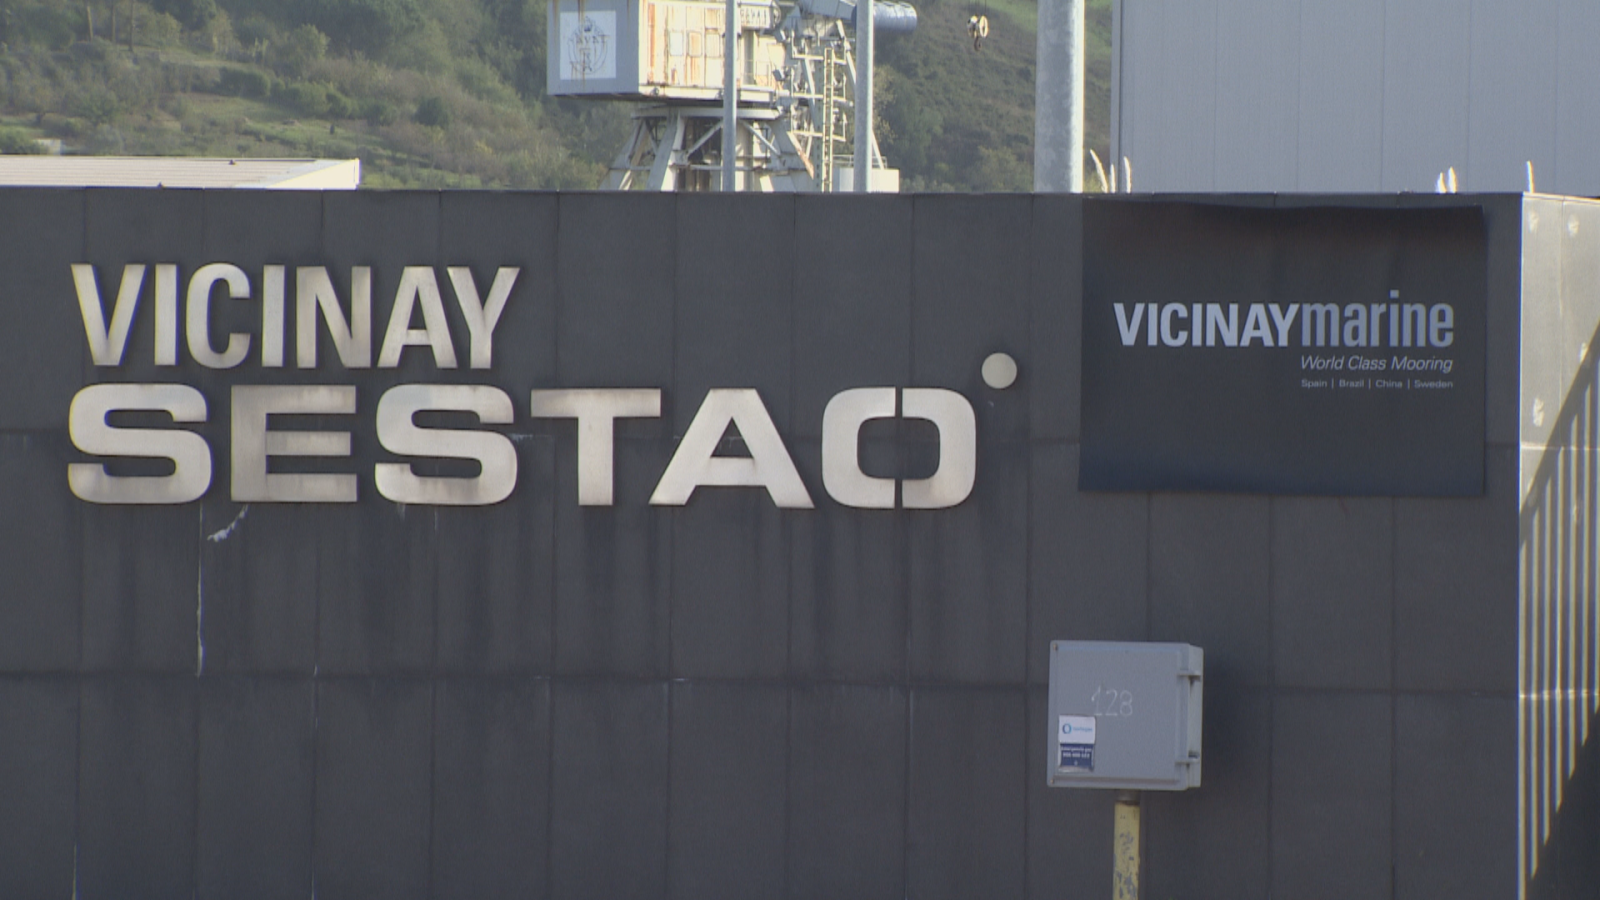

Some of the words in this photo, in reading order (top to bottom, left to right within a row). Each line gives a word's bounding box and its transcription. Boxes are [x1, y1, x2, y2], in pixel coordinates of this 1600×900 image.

[70, 263, 521, 369] VICINAY
[1301, 355, 1344, 371] World
[1348, 355, 1387, 371] Class
[1391, 356, 1453, 374] Mooring
[1301, 378, 1328, 389] Spain
[1339, 379, 1364, 388] Brazil
[1375, 379, 1403, 388] China
[1414, 379, 1453, 389] Sweden
[67, 382, 977, 509] SESTAO
[1091, 685, 1133, 717] 128
